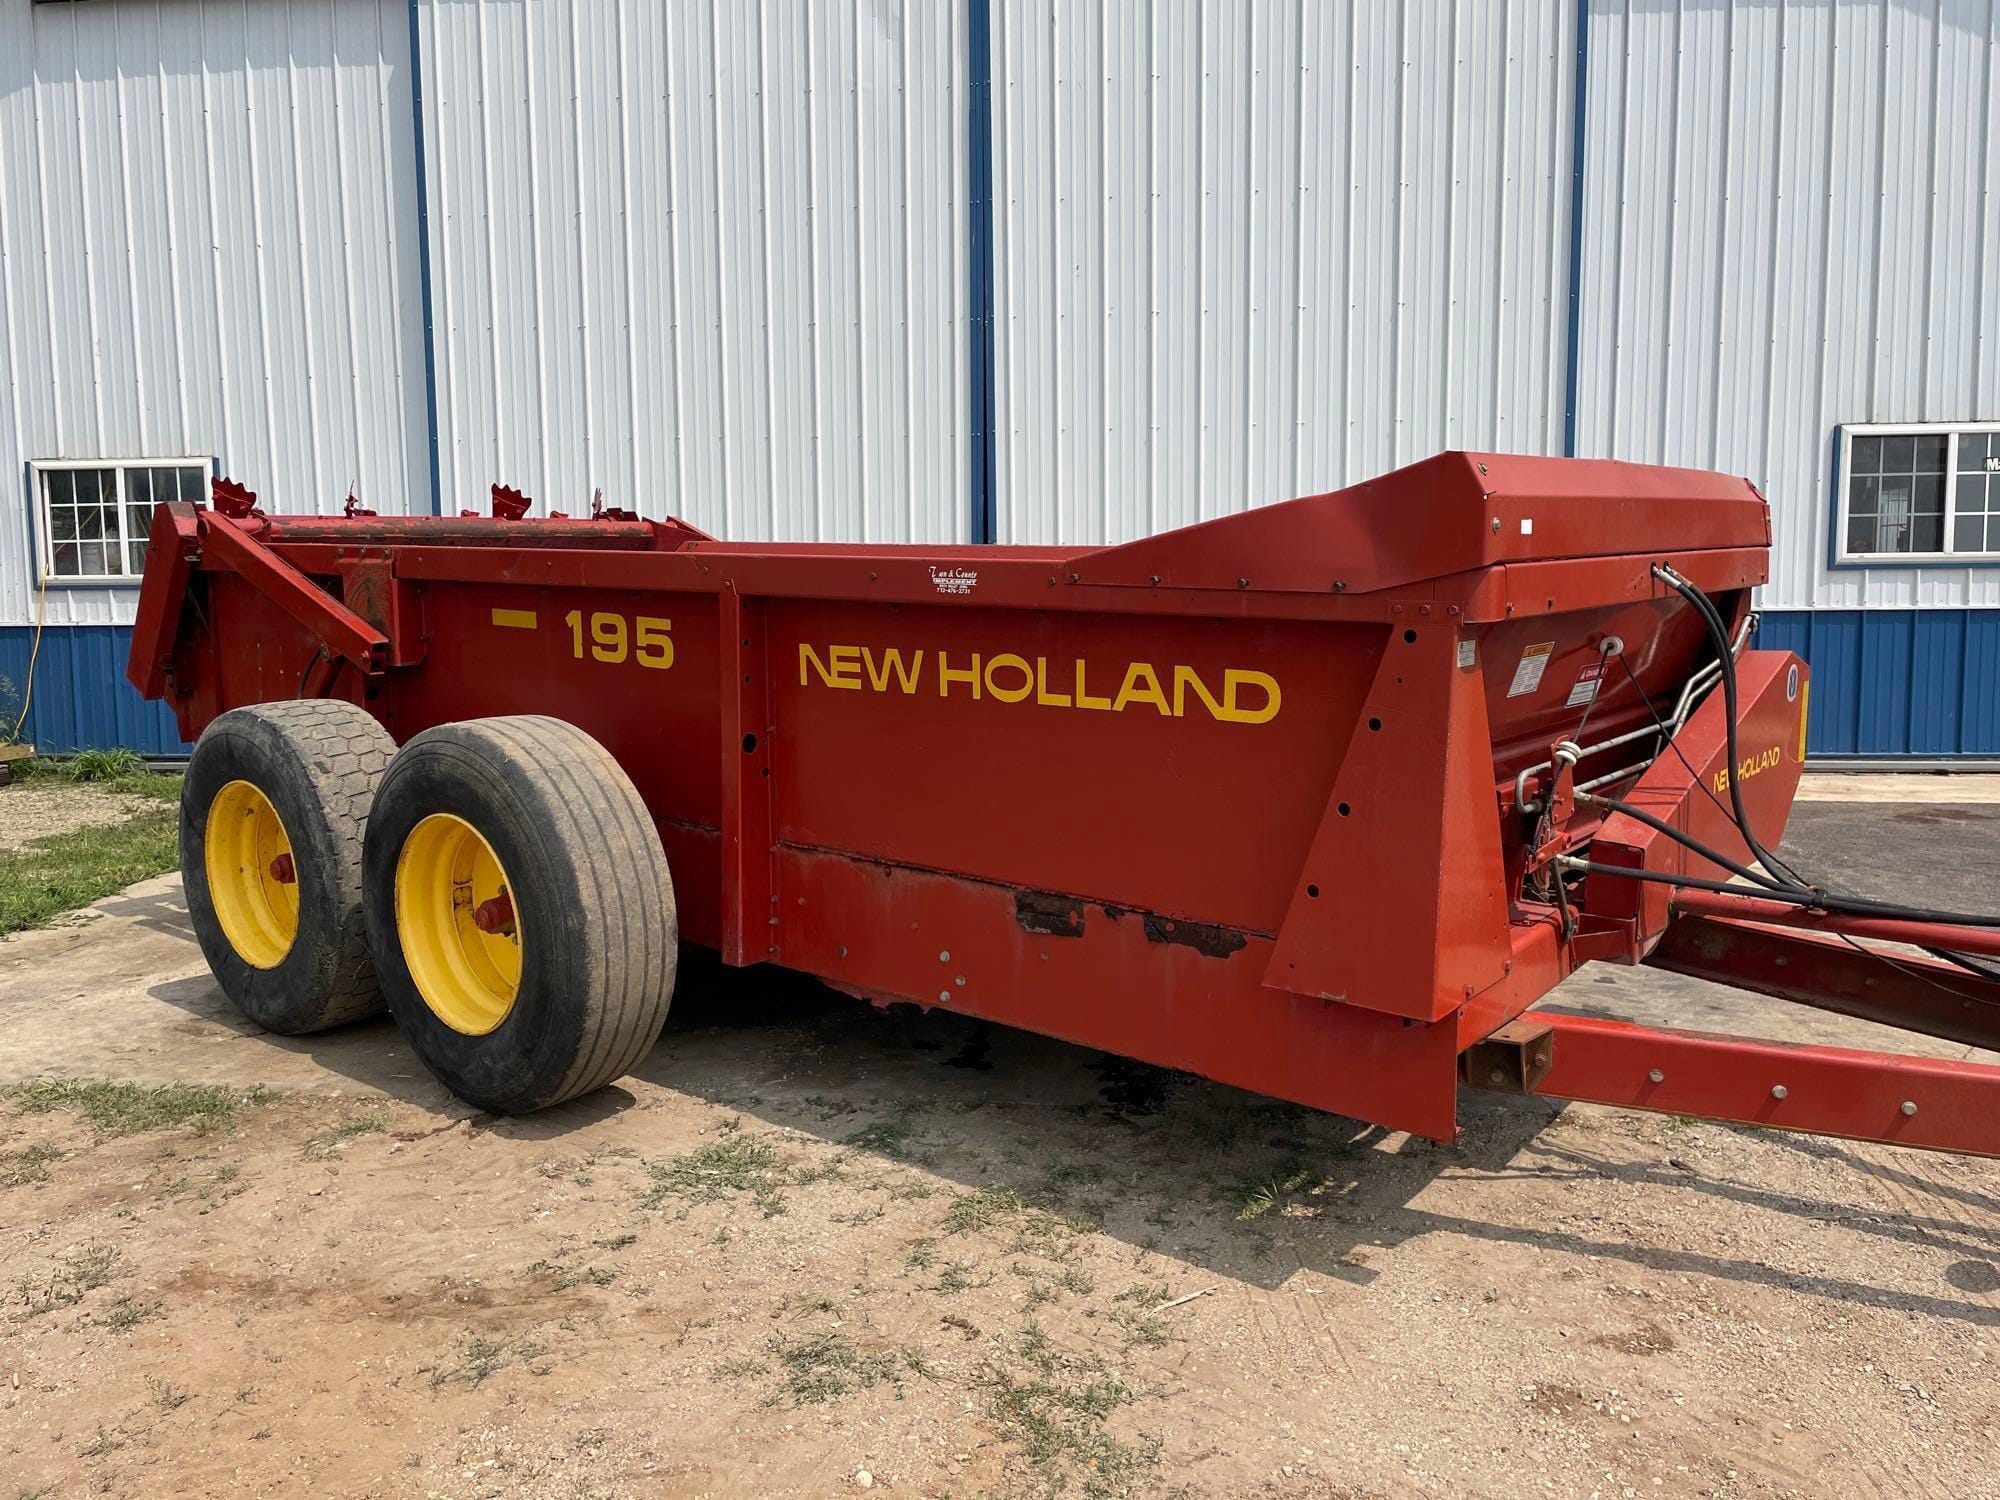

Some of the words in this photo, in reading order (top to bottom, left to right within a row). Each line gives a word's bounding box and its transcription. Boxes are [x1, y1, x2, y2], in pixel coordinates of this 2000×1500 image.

[948, 569, 954, 578] &
[565, 609, 674, 670] 195
[799, 643, 924, 695] NEW
[938, 651, 1282, 724] HOLLAND
[1737, 746, 1780, 781] HOLLAND
